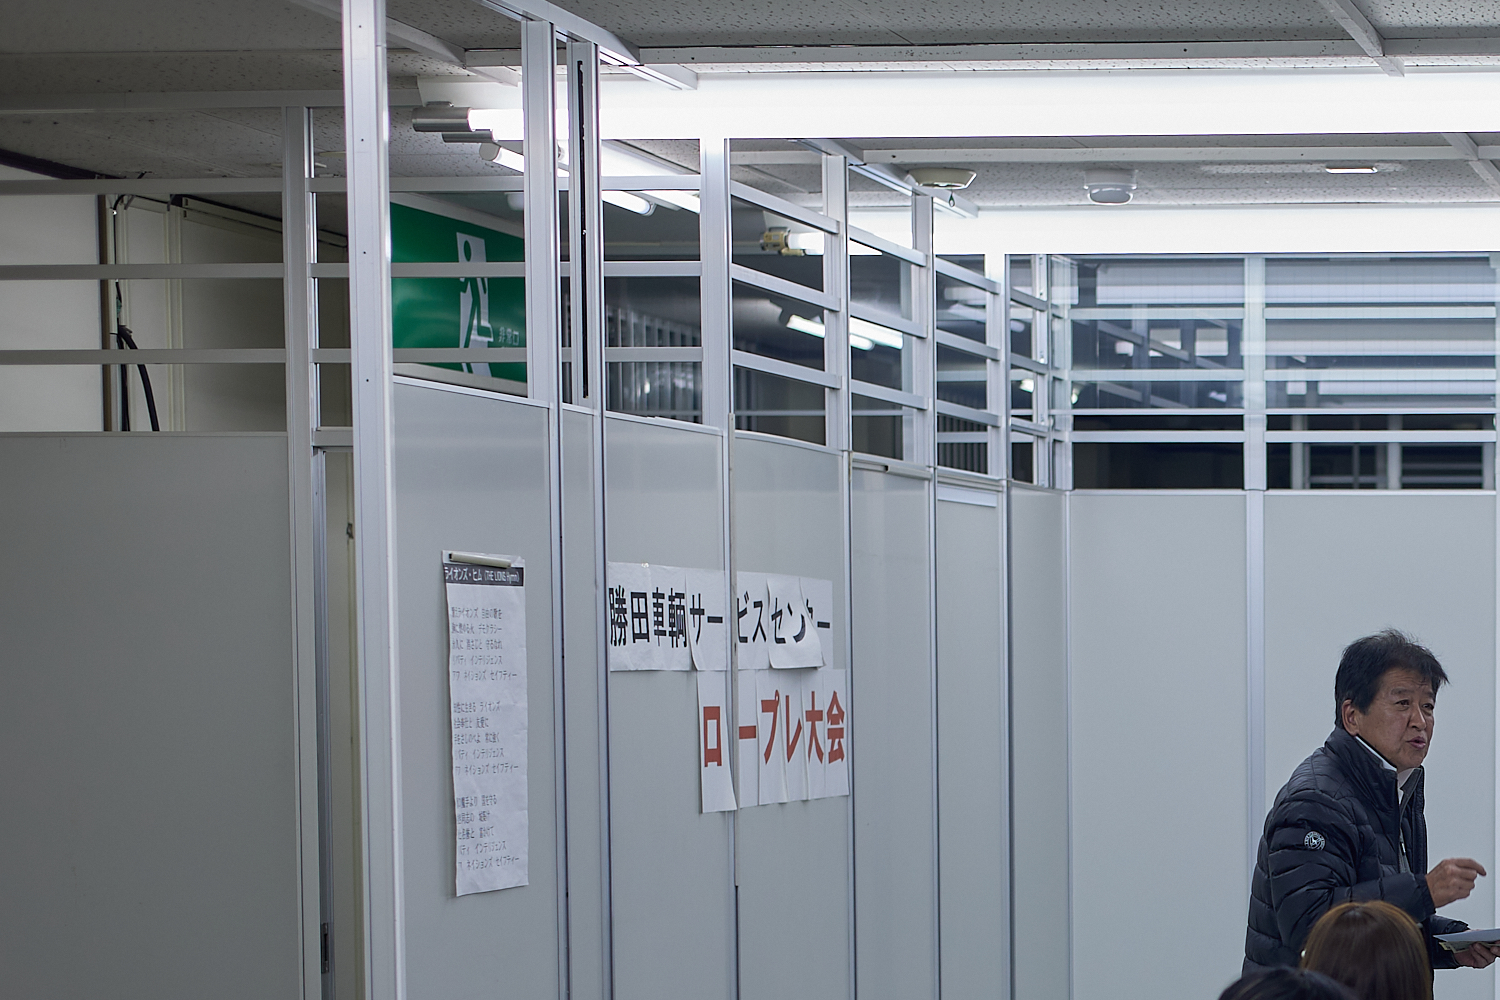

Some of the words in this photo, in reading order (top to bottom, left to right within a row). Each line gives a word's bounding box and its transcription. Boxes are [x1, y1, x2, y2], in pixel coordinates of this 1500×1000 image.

[703, 689, 844, 767] ロープレ大会
